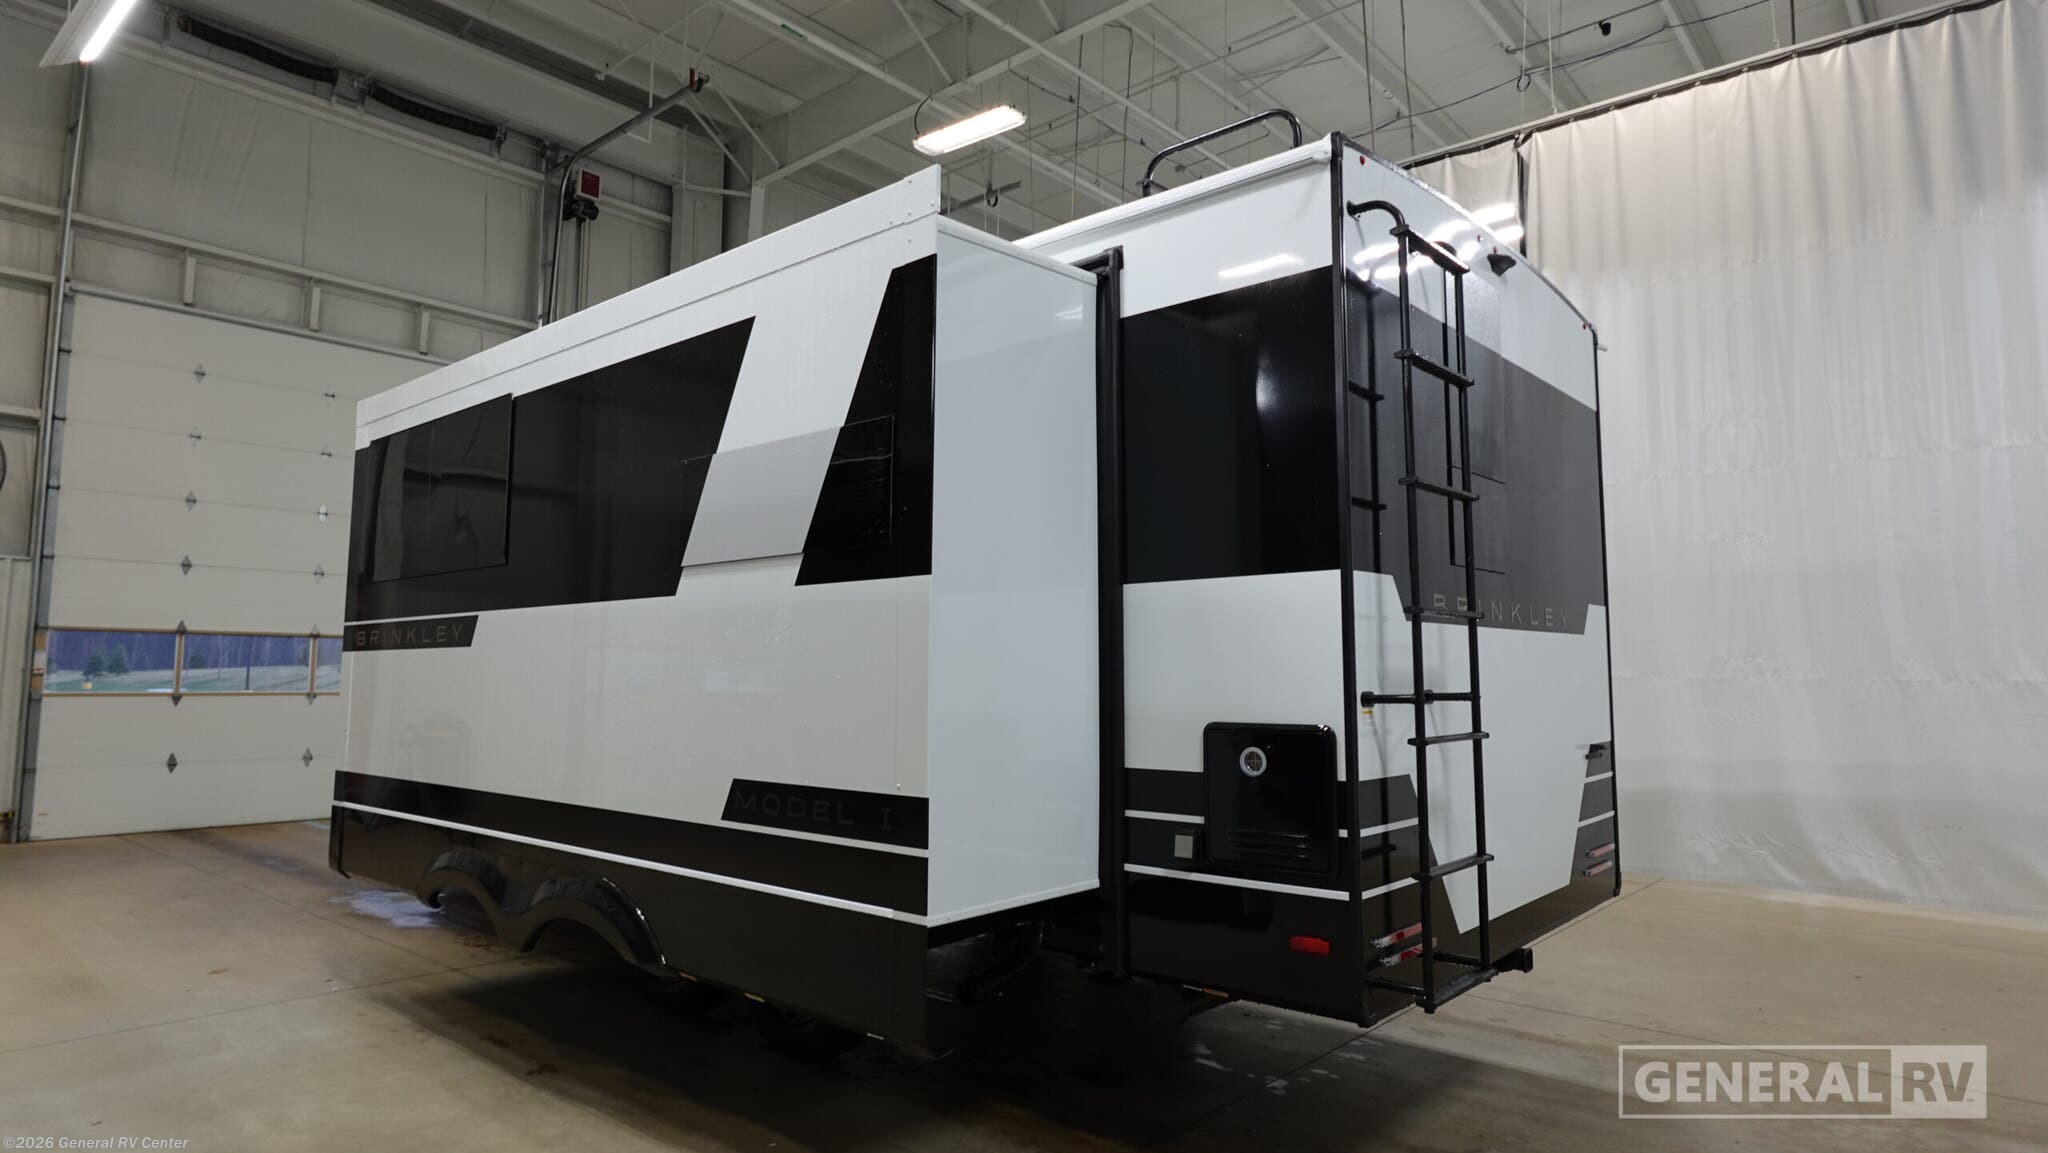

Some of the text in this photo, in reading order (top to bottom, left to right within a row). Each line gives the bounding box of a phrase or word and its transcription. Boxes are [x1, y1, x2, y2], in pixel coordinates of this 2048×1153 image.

[356, 624, 463, 647] BRINKLEY
[734, 790, 892, 832] MODEL I
